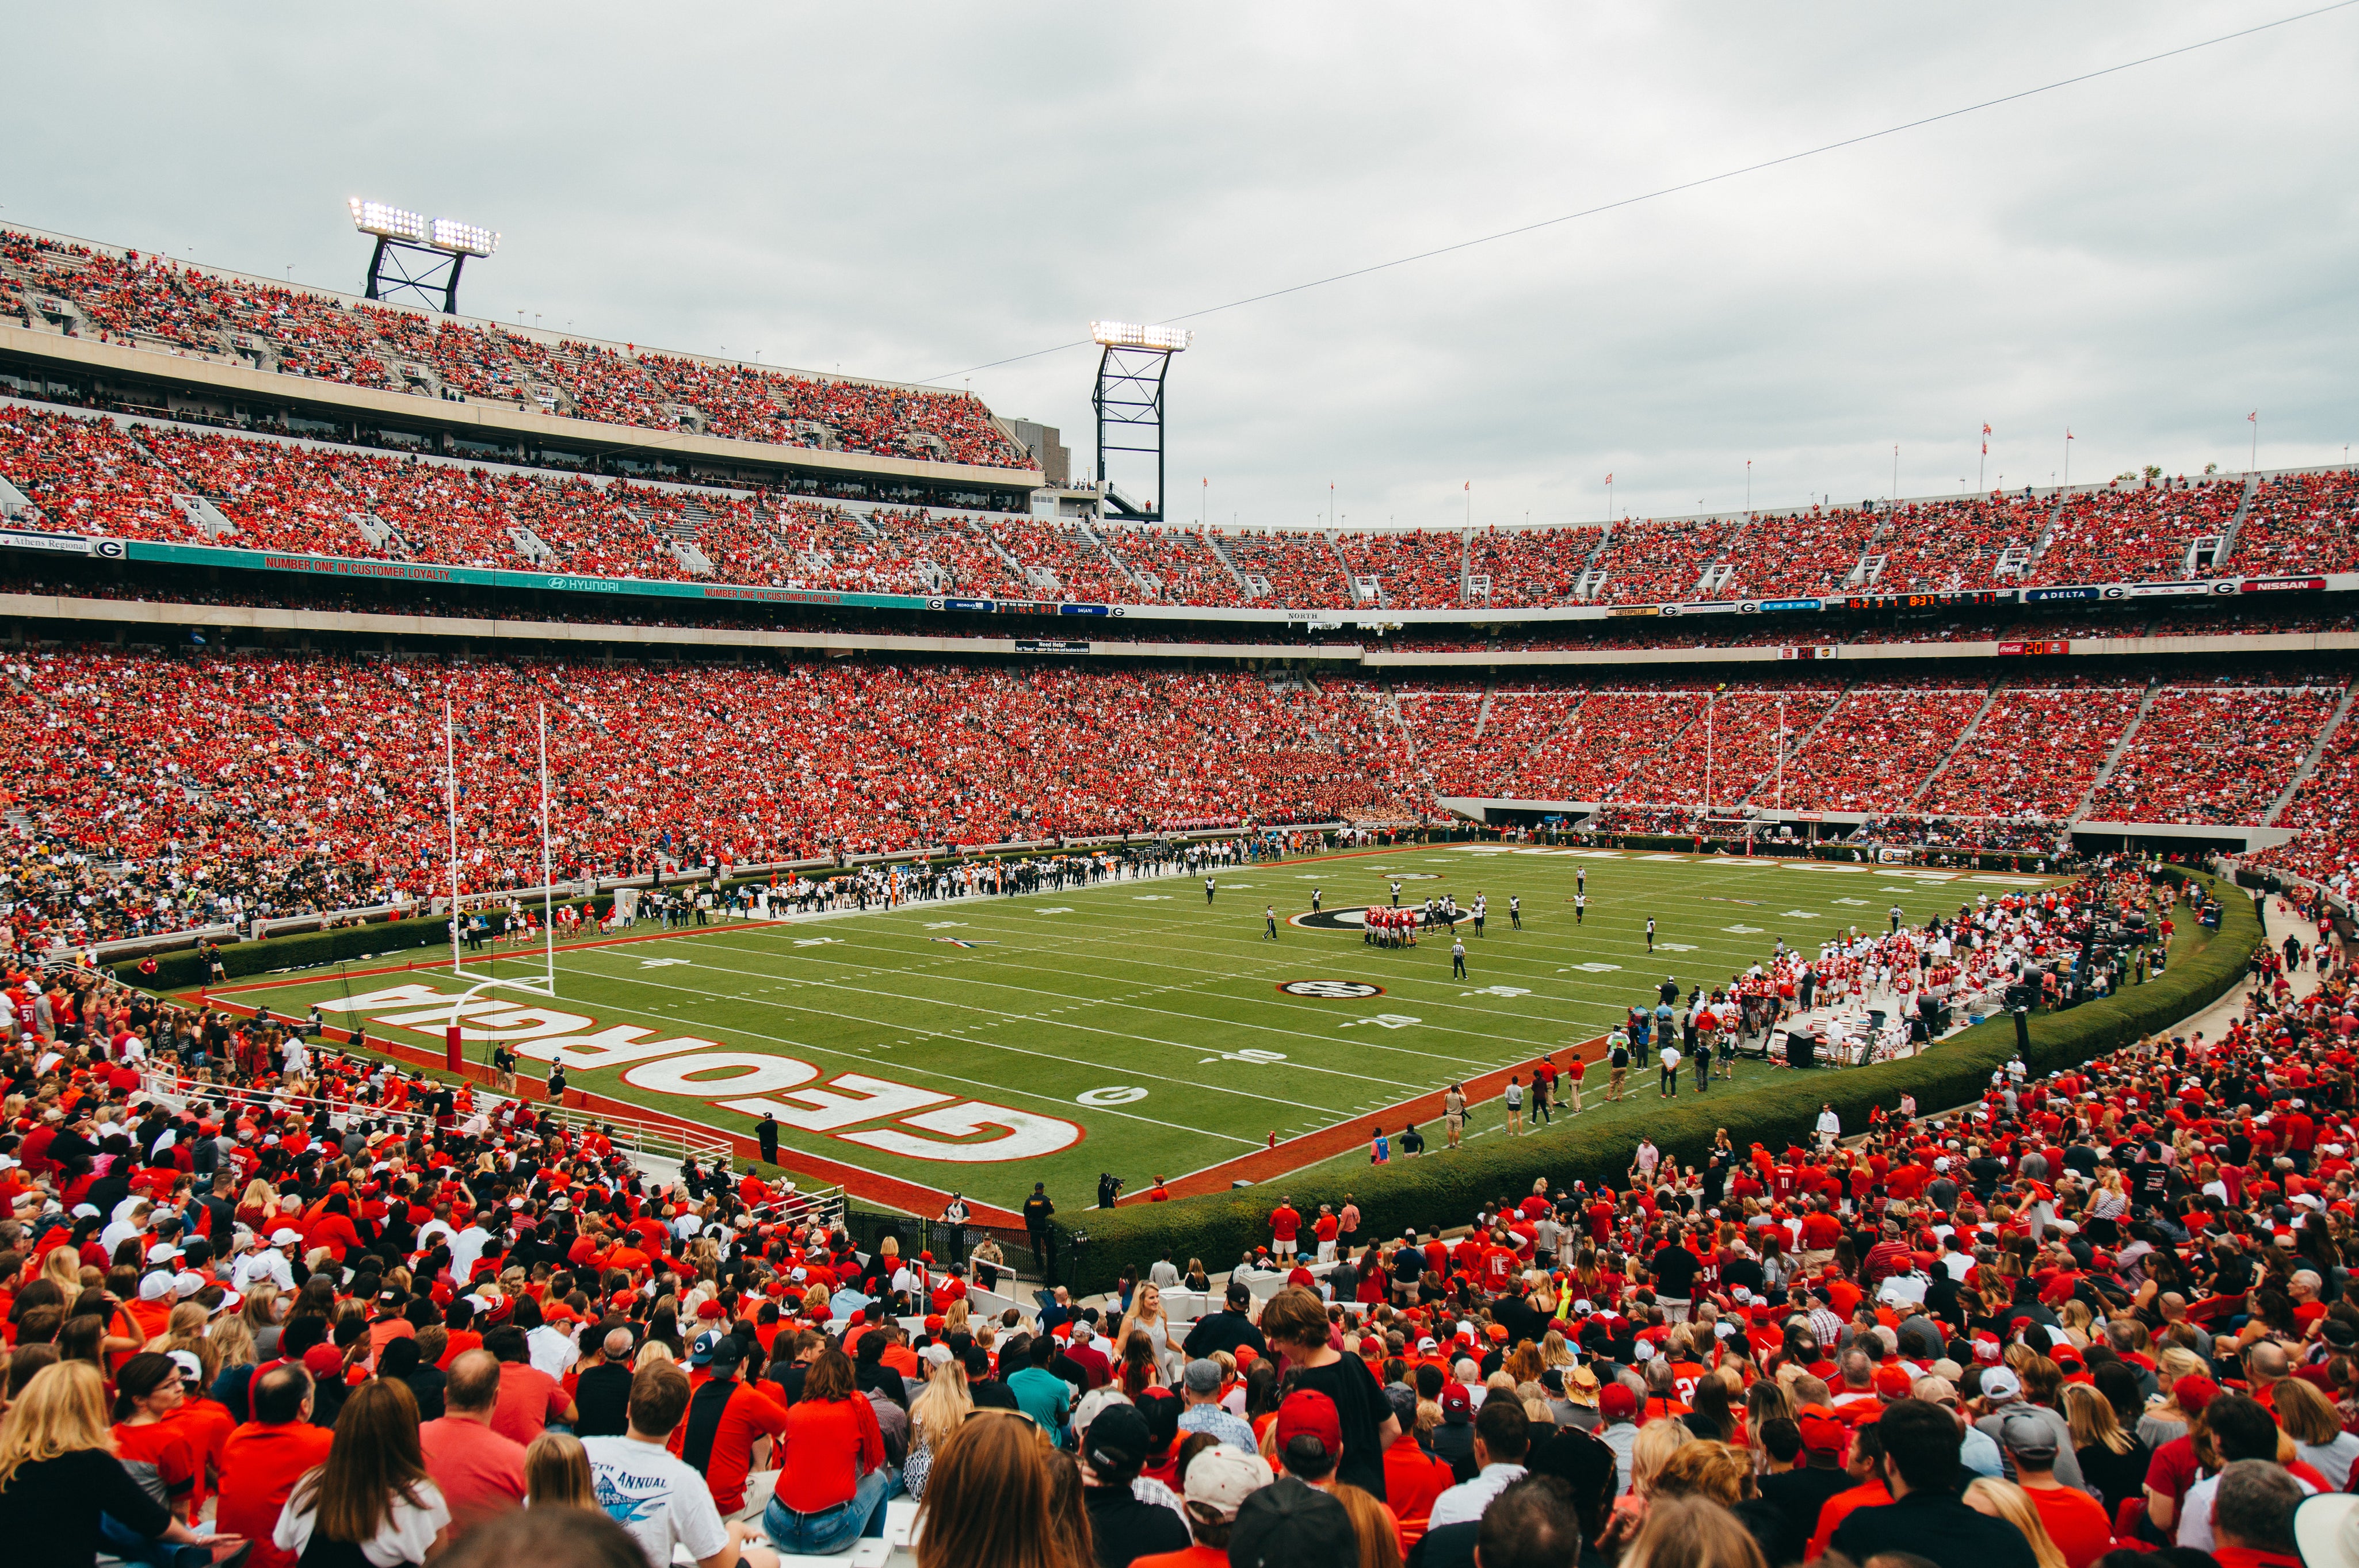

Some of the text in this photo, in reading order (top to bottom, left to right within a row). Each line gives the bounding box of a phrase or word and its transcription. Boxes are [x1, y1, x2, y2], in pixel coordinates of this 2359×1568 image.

[14, 537, 87, 550] Athens Regional
[265, 557, 453, 581] NUMBER ONE IN CUSTOMER LOYALTY.
[569, 579, 619, 592] HYUNDAI
[2257, 582, 2308, 590] NISSAN
[705, 588, 842, 603] NUMBER ONE IN CUSTOMER LOYALTY.
[1910, 595, 1934, 606] 8:37
[1041, 605, 1056, 613] 8:37
[1850, 598, 1860, 608] 16
[1800, 648, 1814, 659] 20
[2025, 642, 2043, 655] 20
[1440, 845, 2056, 886] BULLDOGS
[22, 1009, 33, 1022] 51
[1222, 1049, 1287, 1065] 10
[1357, 1014, 1421, 1029] 20
[1474, 986, 1532, 998] 30
[308, 982, 1087, 1163] GEORGIA
[1703, 1265, 1717, 1282] 34
[936, 1276, 954, 1291] 81
[617, 1471, 666, 1489] ANNUAL
